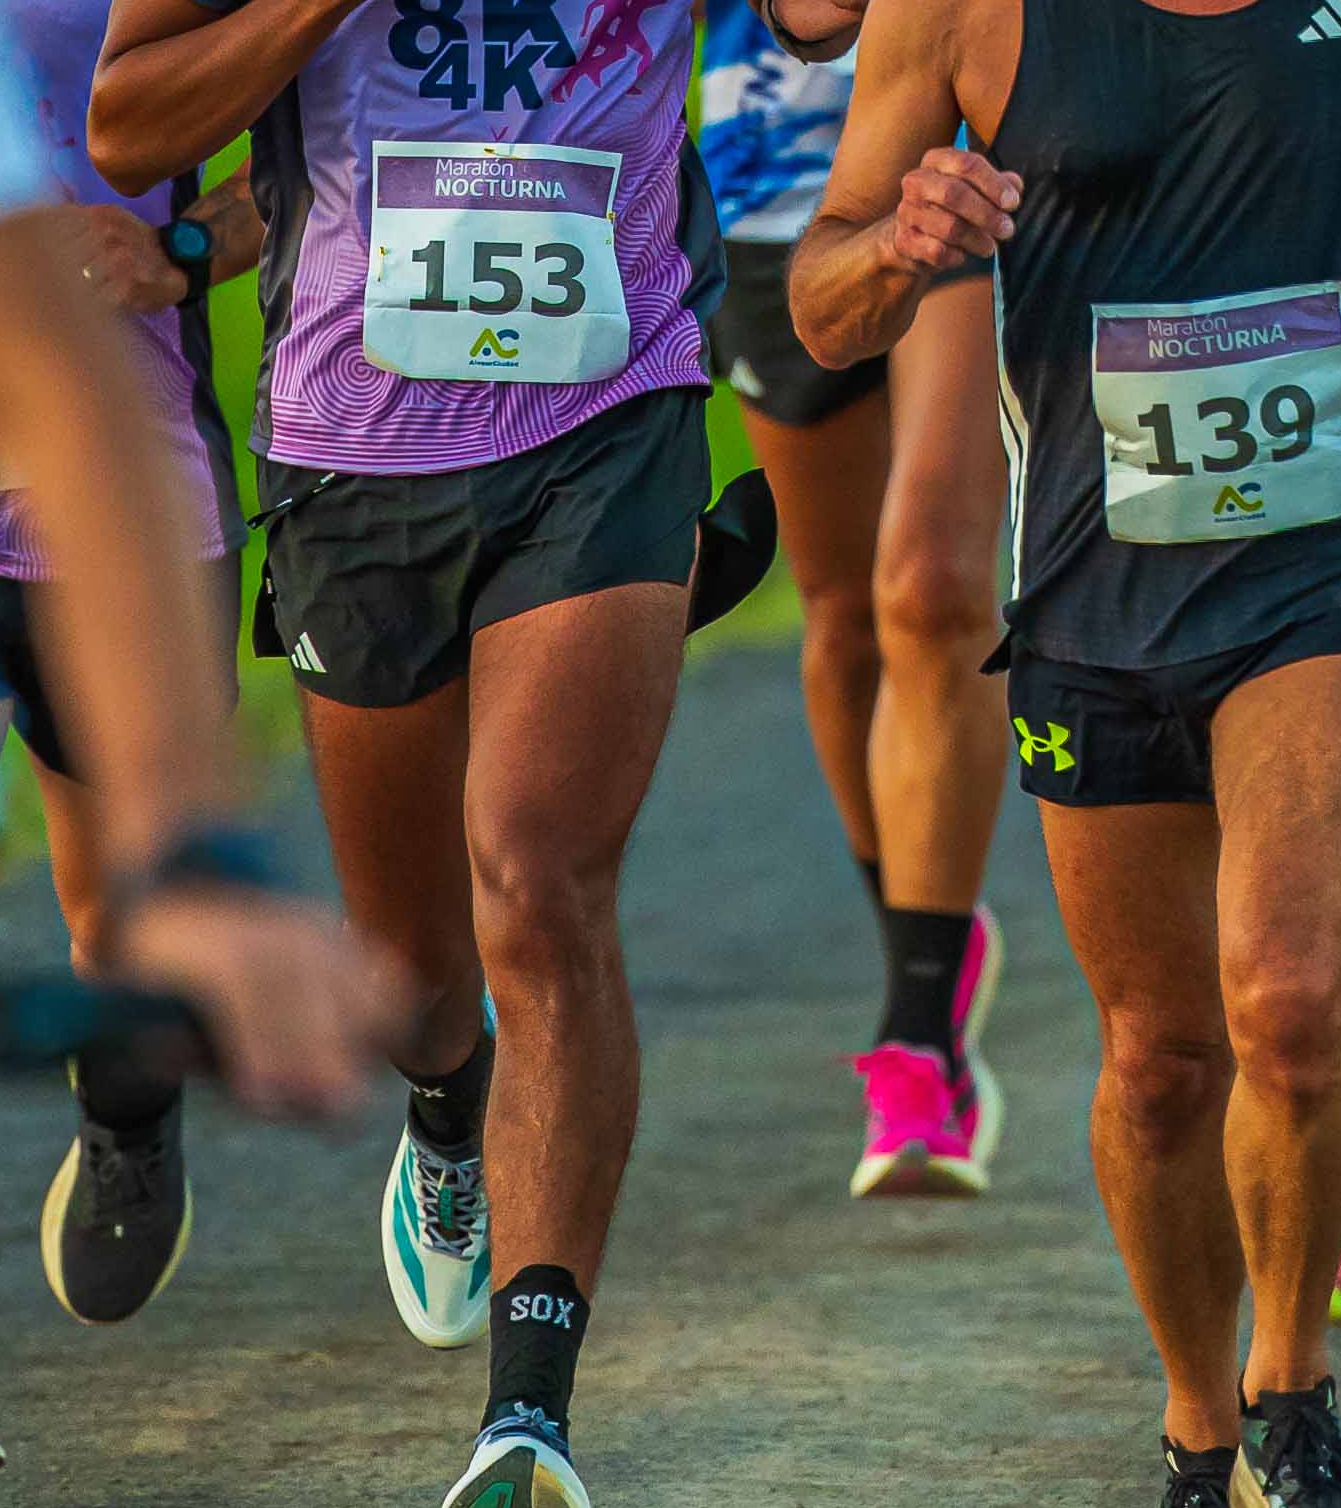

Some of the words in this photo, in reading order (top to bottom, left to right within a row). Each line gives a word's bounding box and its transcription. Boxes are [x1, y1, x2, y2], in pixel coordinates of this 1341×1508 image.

[418, 40, 543, 112] 4K
[435, 158, 513, 177] Maratón
[435, 178, 566, 199] NOCTURNA
[409, 240, 586, 318] 153
[1147, 315, 1228, 337] Maratón
[1148, 323, 1287, 360] NOCTURNA
[1137, 384, 1316, 477] 139
[510, 1294, 575, 1329] SOX
